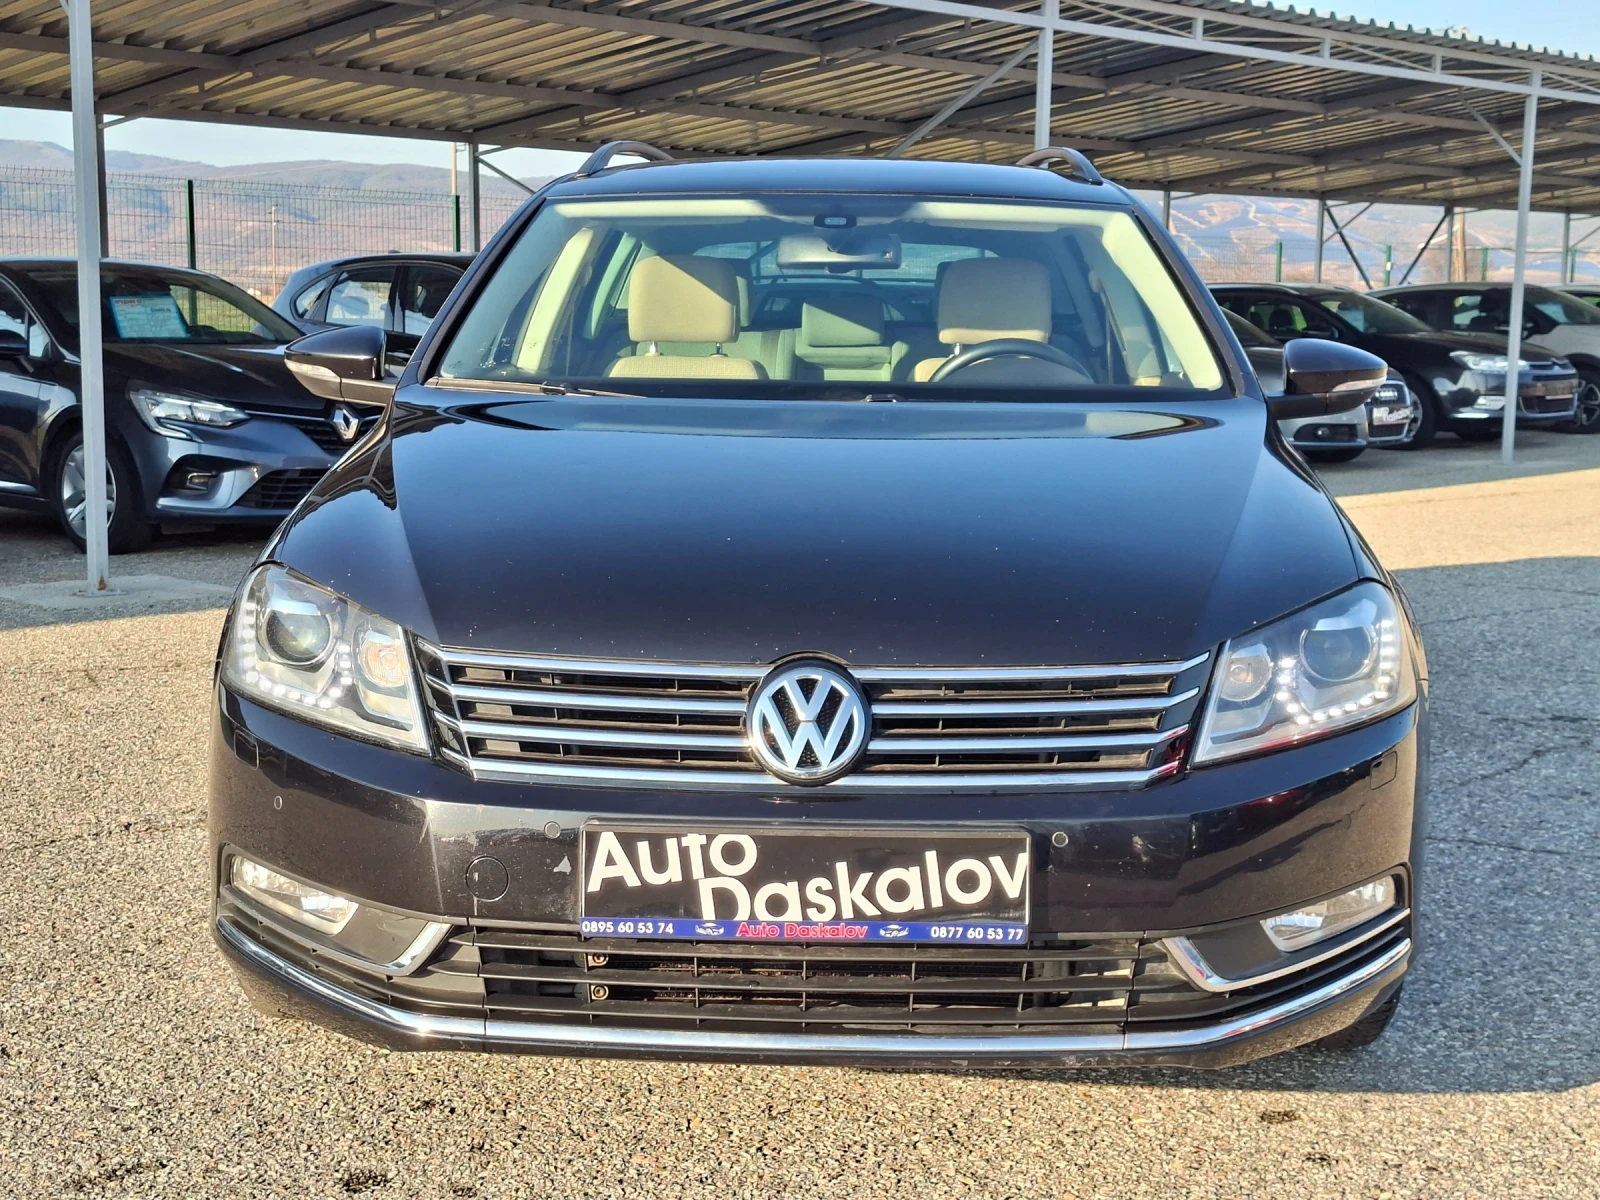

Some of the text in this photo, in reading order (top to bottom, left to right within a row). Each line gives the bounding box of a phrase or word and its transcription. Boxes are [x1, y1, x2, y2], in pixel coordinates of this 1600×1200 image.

[758, 673, 858, 771] VW
[587, 831, 758, 893] Auto
[698, 850, 1028, 922] Daskalov
[581, 921, 674, 935] 0895 60 53 74
[735, 922, 868, 939] Auto Daskalov
[930, 926, 1024, 941] 0877 60 53 77
